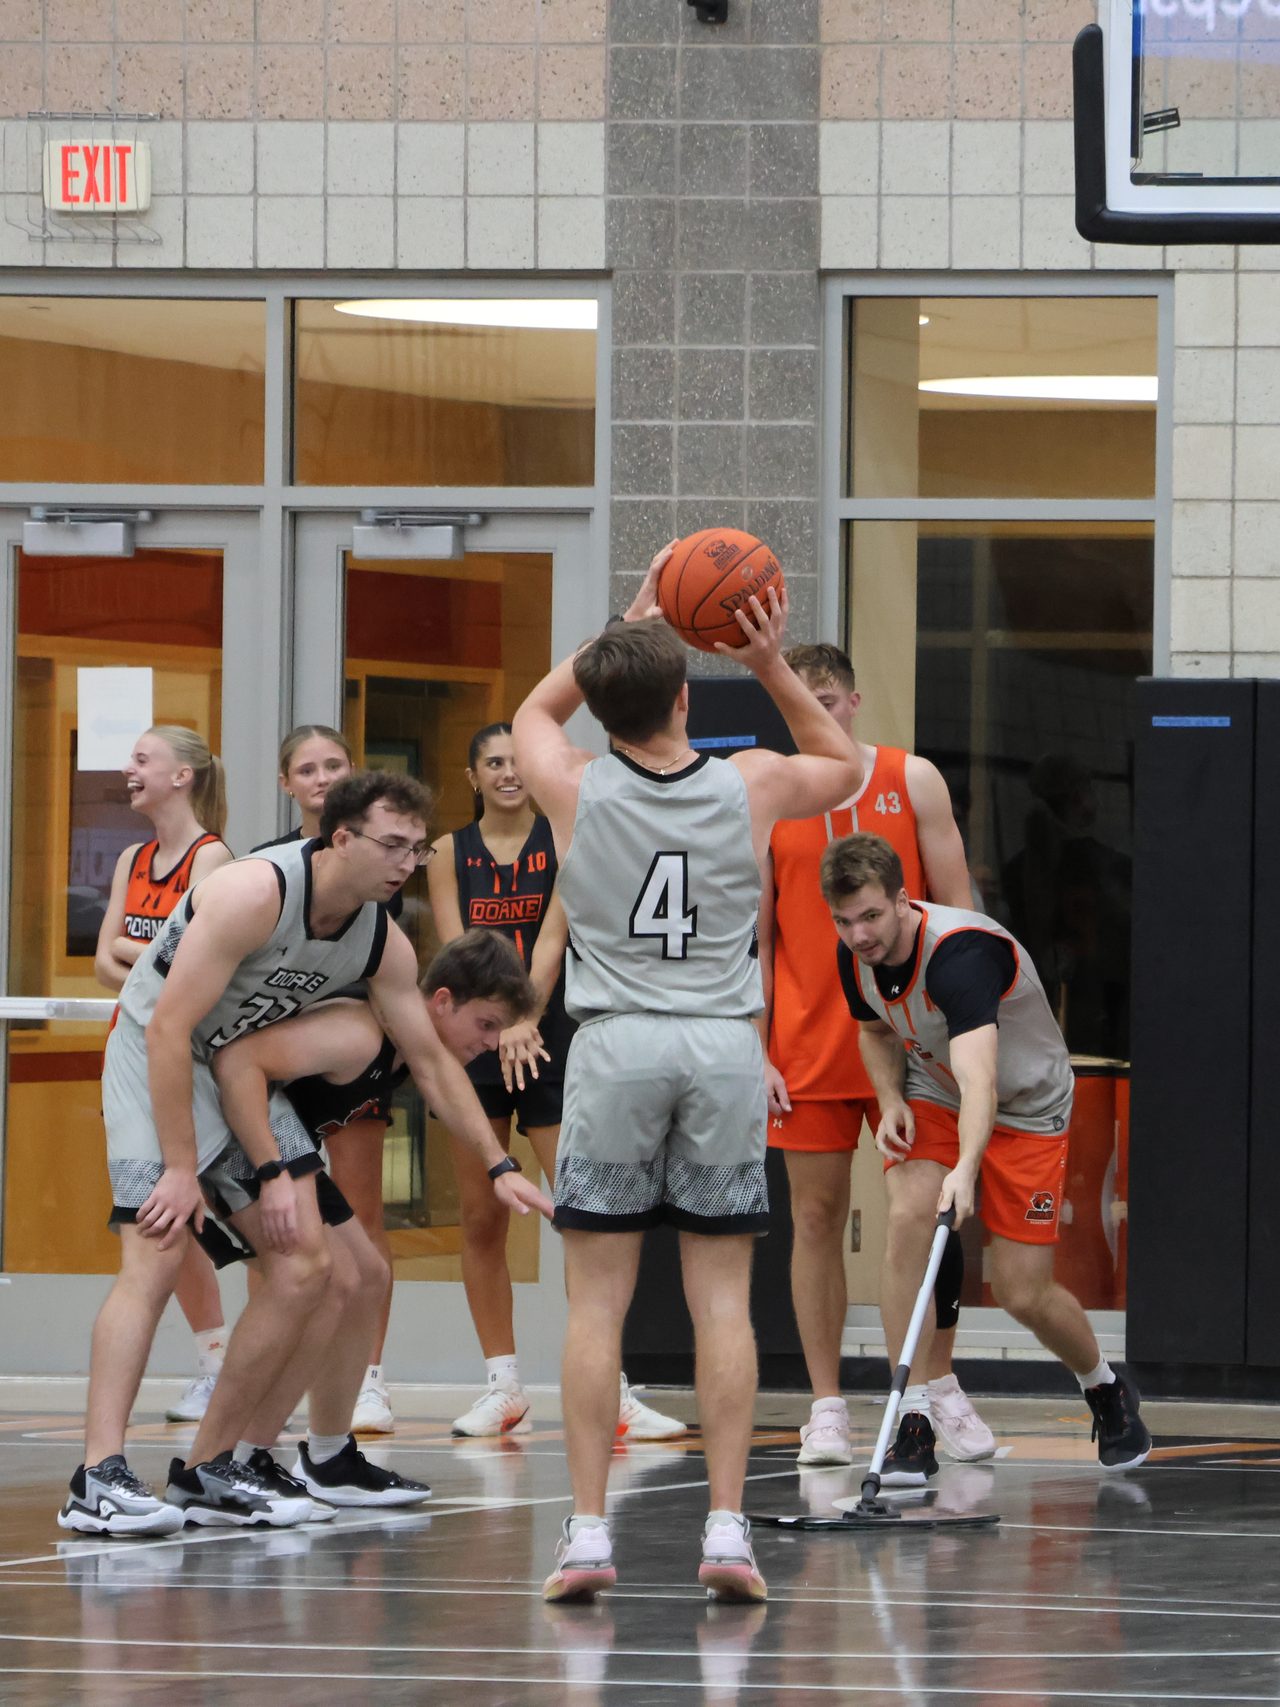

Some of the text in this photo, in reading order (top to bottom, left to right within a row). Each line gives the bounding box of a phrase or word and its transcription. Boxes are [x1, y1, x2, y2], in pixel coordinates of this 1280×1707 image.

[61, 145, 131, 203] EXIT
[719, 560, 779, 617] SPALDING
[875, 791, 901, 815] 43
[527, 851, 546, 873] 10
[471, 900, 539, 920] DOANE
[629, 851, 697, 960] 4
